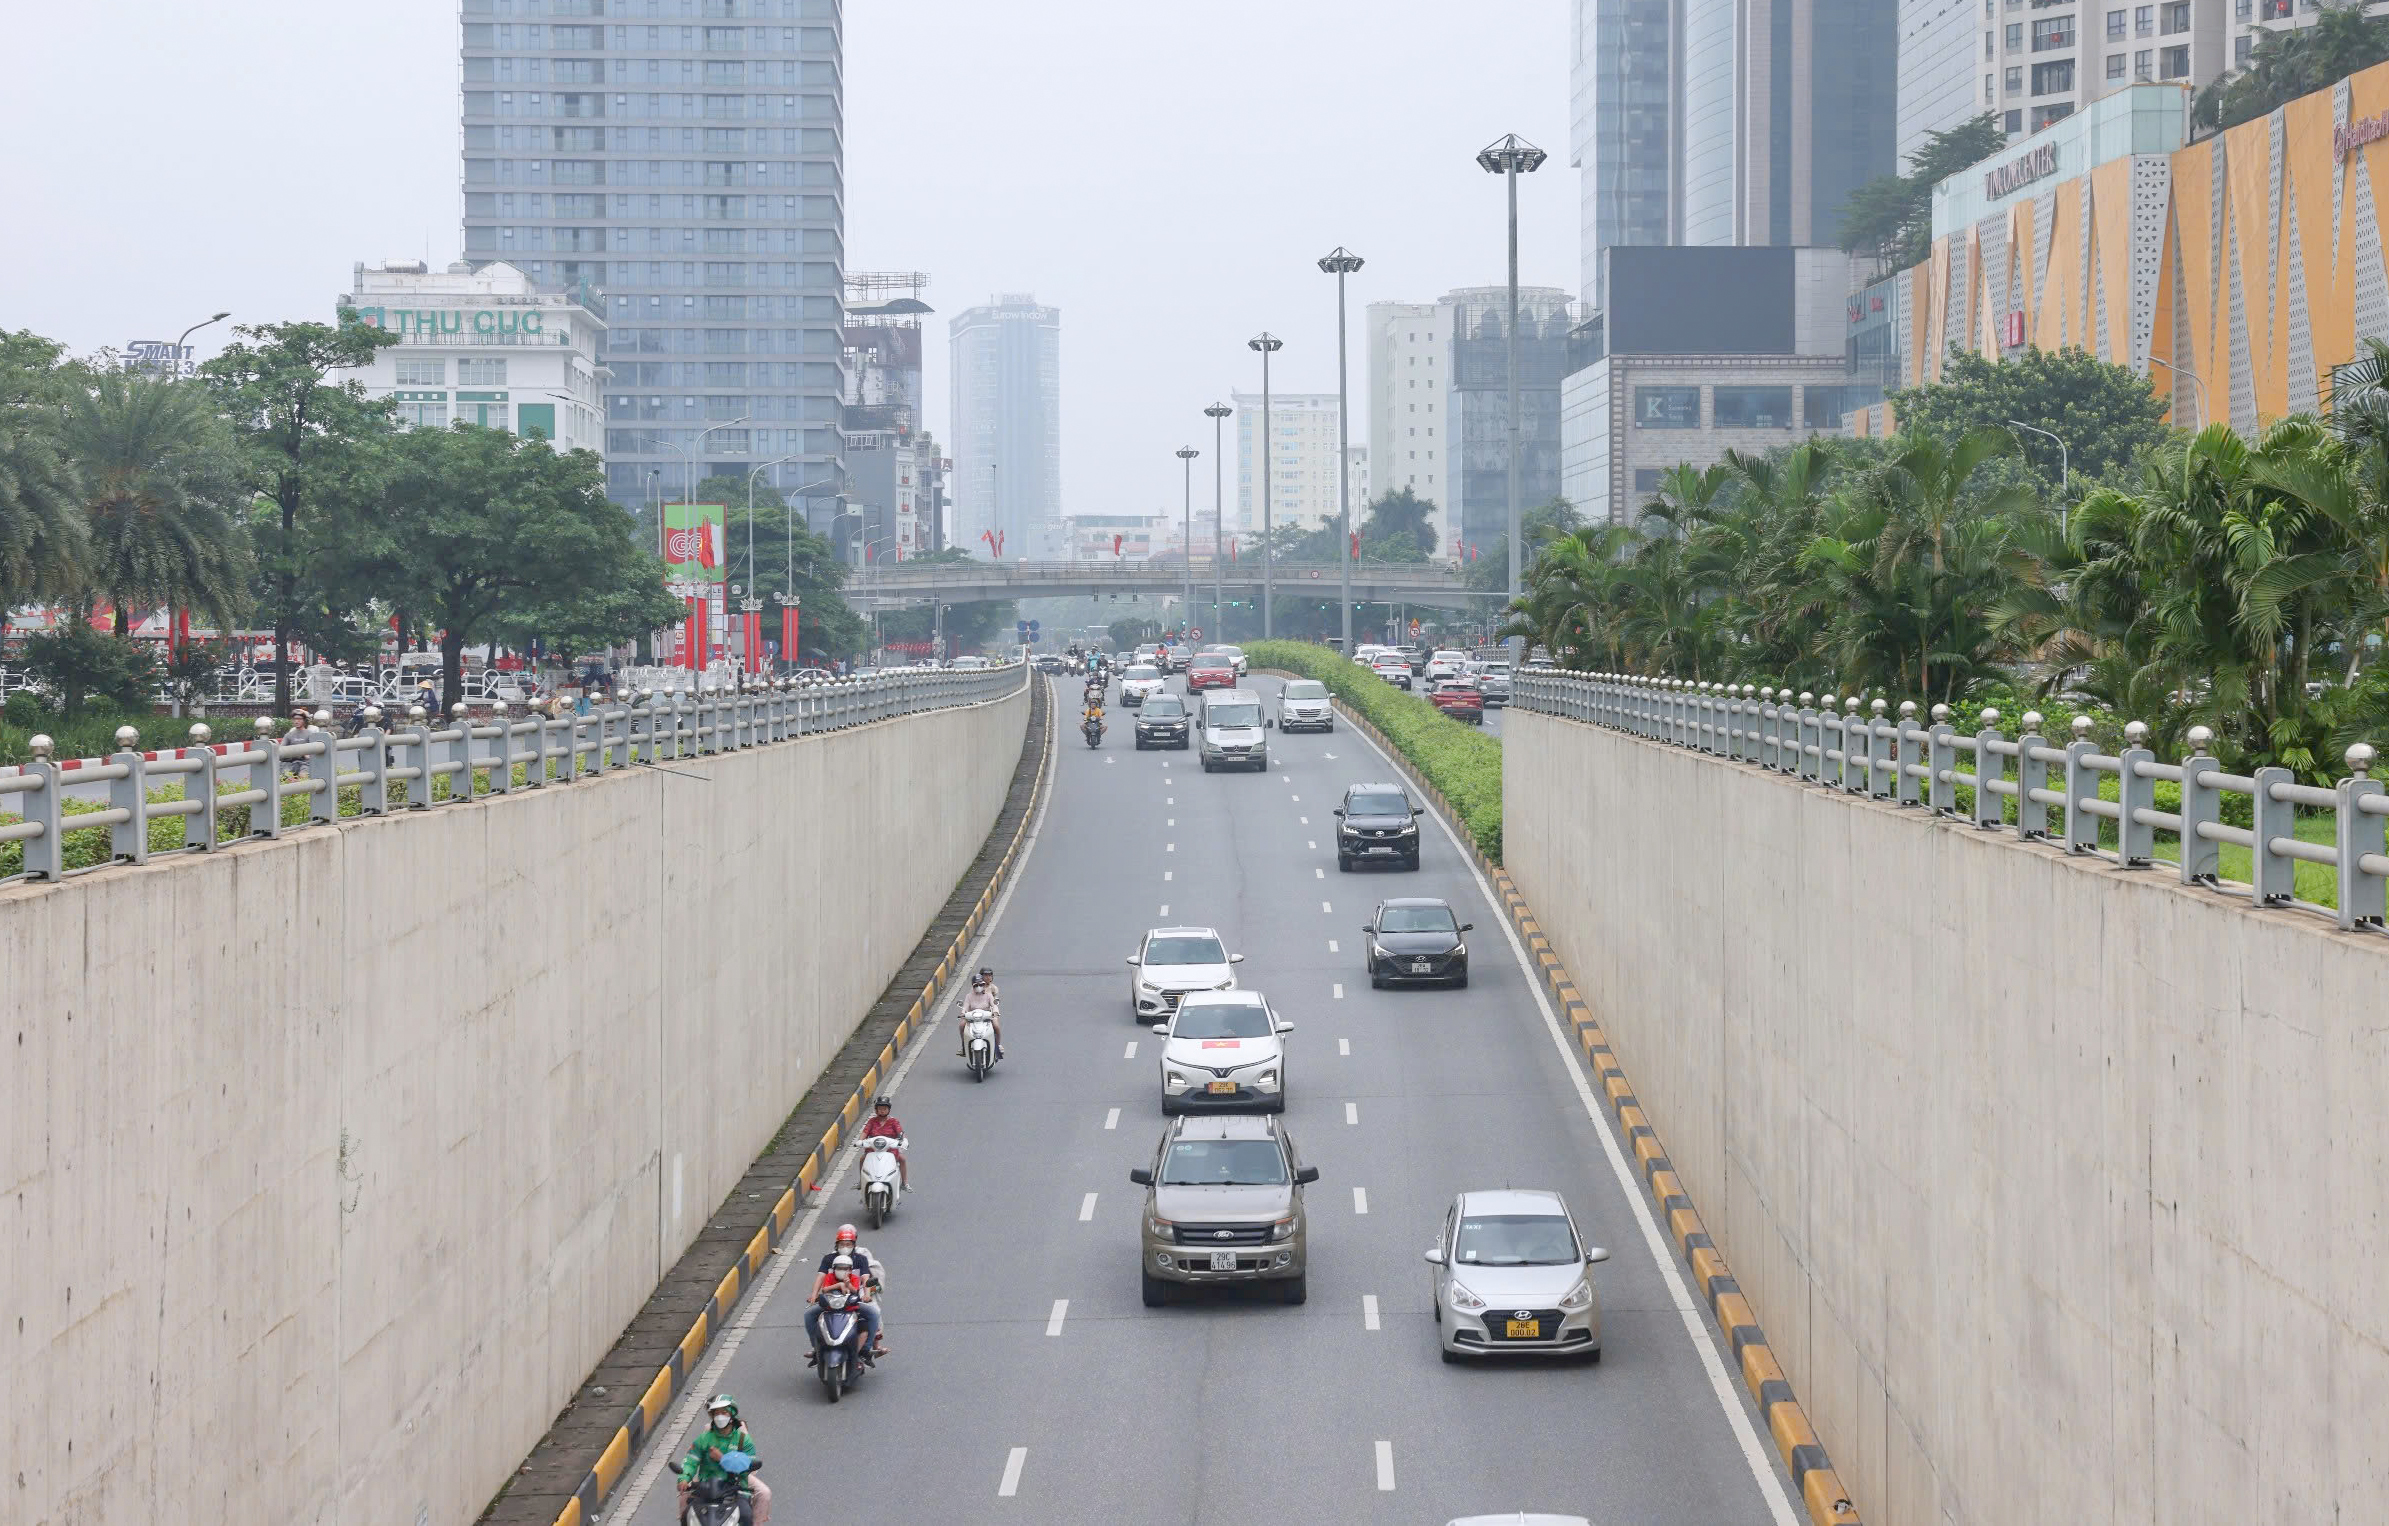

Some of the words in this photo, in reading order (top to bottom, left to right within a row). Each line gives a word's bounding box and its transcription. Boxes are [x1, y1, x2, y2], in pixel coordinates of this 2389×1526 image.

[1985, 160, 2020, 202] VINCOM
[2020, 143, 2055, 184] CENTER
[393, 310, 461, 335] THU
[1216, 1252, 1231, 1261] 29C
